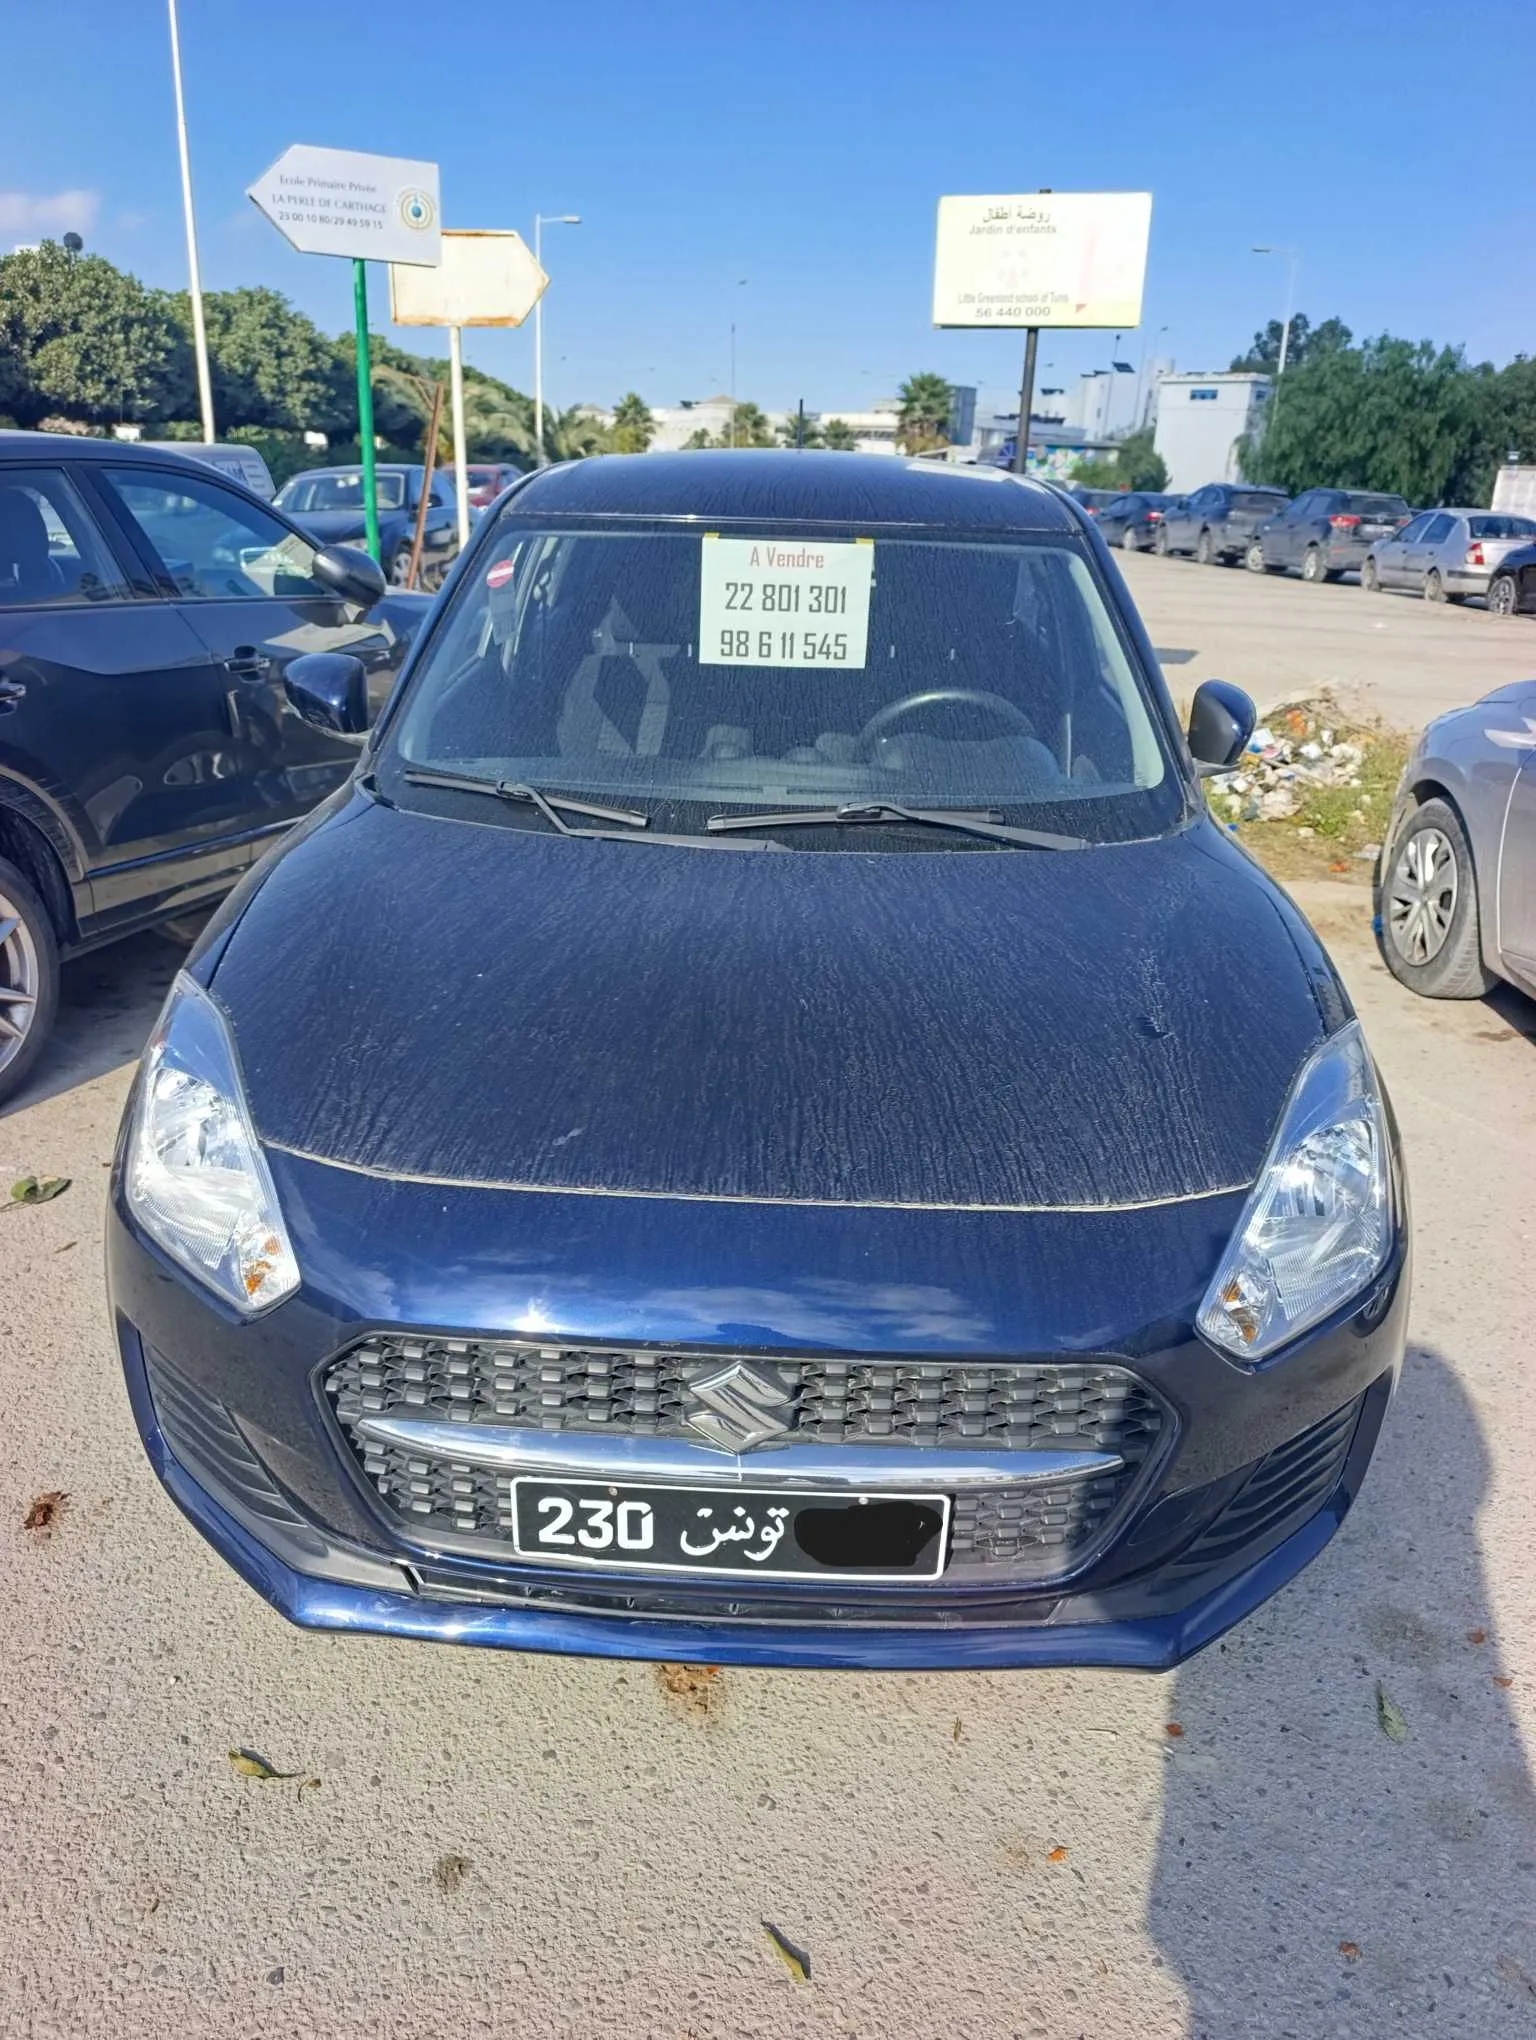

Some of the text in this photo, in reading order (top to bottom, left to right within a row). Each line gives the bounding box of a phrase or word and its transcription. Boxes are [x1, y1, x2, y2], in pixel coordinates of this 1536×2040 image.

[280, 174, 305, 186] Ecole
[306, 176, 347, 191] Primaire
[272, 193, 387, 214] LA PERLE DE CARTHAGE
[306, 213, 318, 223] 10
[372, 219, 384, 230] 15
[969, 223, 1058, 236] Jardin d'enfants
[974, 306, 1051, 318] 56 440 000
[750, 546, 825, 569] A Vendre
[725, 582, 847, 614] 22 801 301
[720, 629, 847, 660] 98 6 11 545
[537, 1496, 791, 1561] 230 تونس
